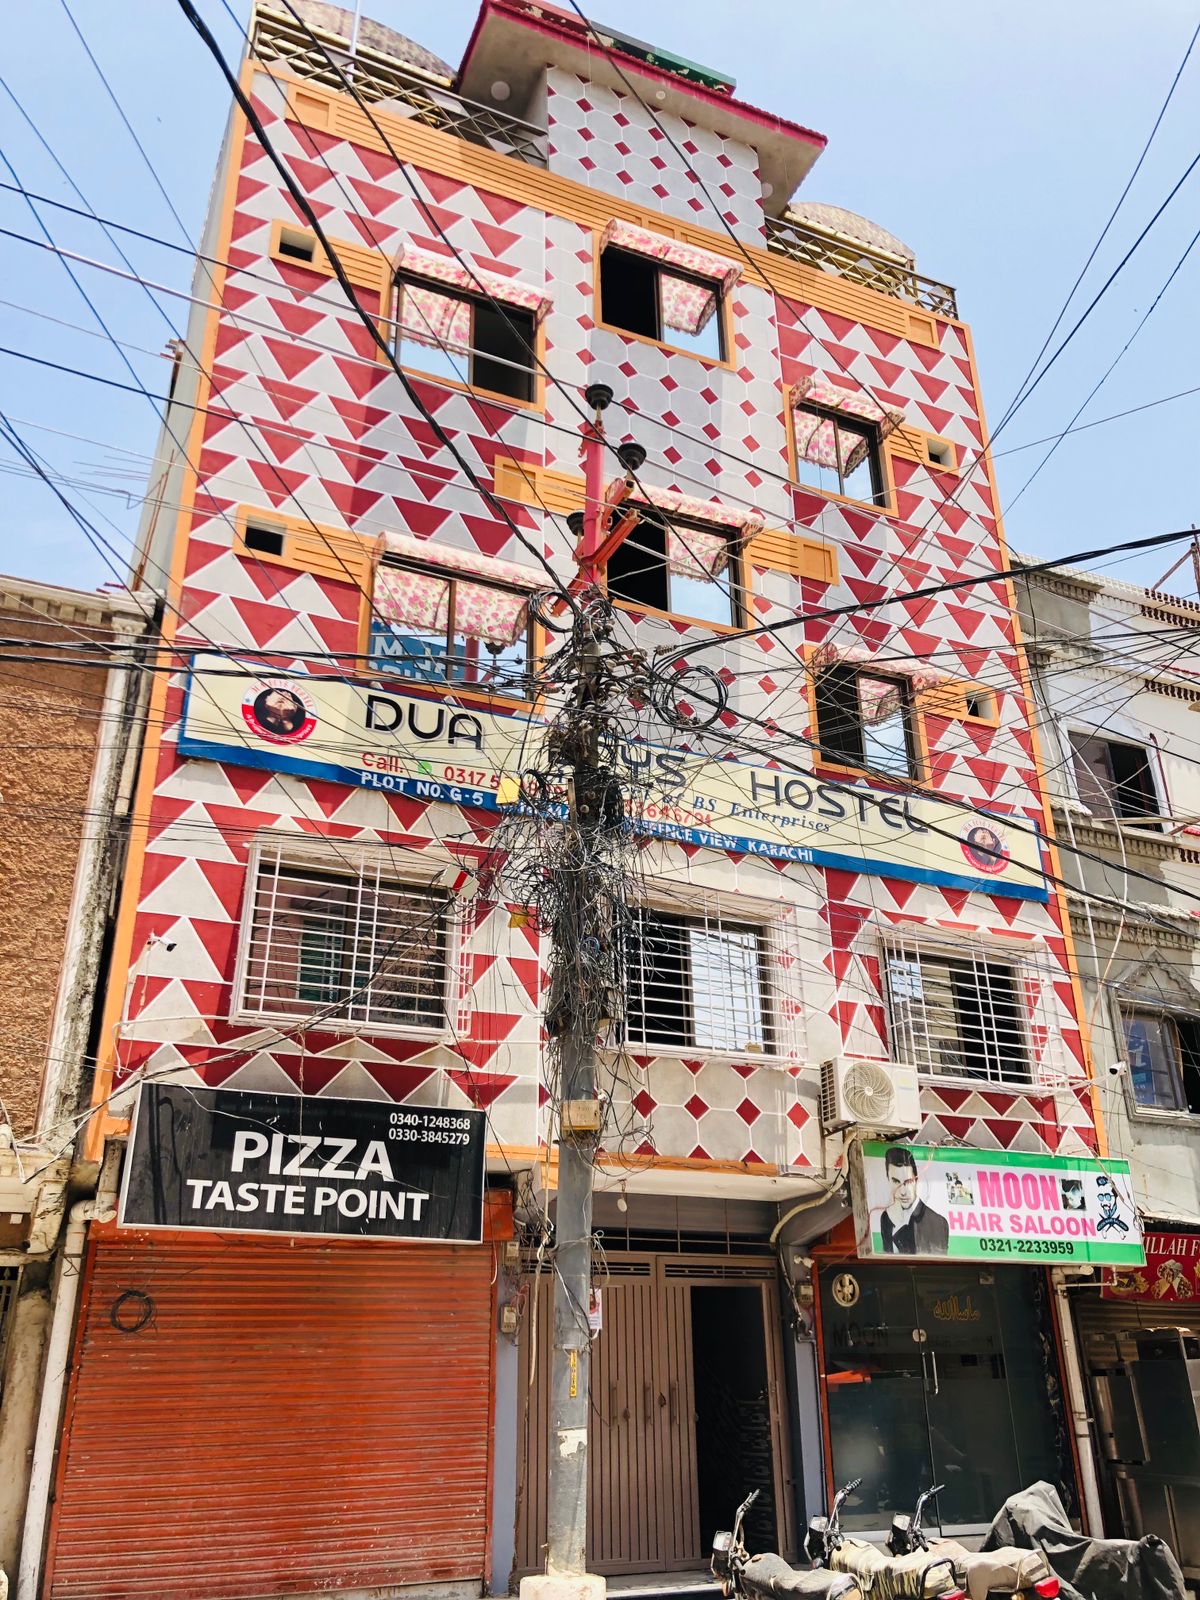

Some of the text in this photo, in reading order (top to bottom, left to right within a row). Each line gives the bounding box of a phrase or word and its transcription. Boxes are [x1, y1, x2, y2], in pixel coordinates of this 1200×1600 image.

[365, 694, 483, 751] DUA
[750, 770, 929, 834] HOSTEL
[361, 771, 408, 792] PLOT
[416, 781, 445, 798] NO.
[450, 787, 484, 806] G-5
[633, 818, 693, 842] EFENCE
[698, 830, 738, 849] VIEW
[748, 840, 813, 862] KARACHI
[693, 795, 717, 812] BS
[731, 801, 830, 833] Enterprises
[388, 1128, 471, 1146] 0330-3845279
[389, 1112, 471, 1131] 0340-1248368
[230, 1130, 395, 1182] PIZZA
[186, 1178, 430, 1222] TASTE POINT
[976, 1170, 1060, 1212] MOON
[948, 1210, 1004, 1233] HAIR
[1009, 1214, 1097, 1237] SALOON
[979, 1238, 1074, 1255] 0321-2233959
